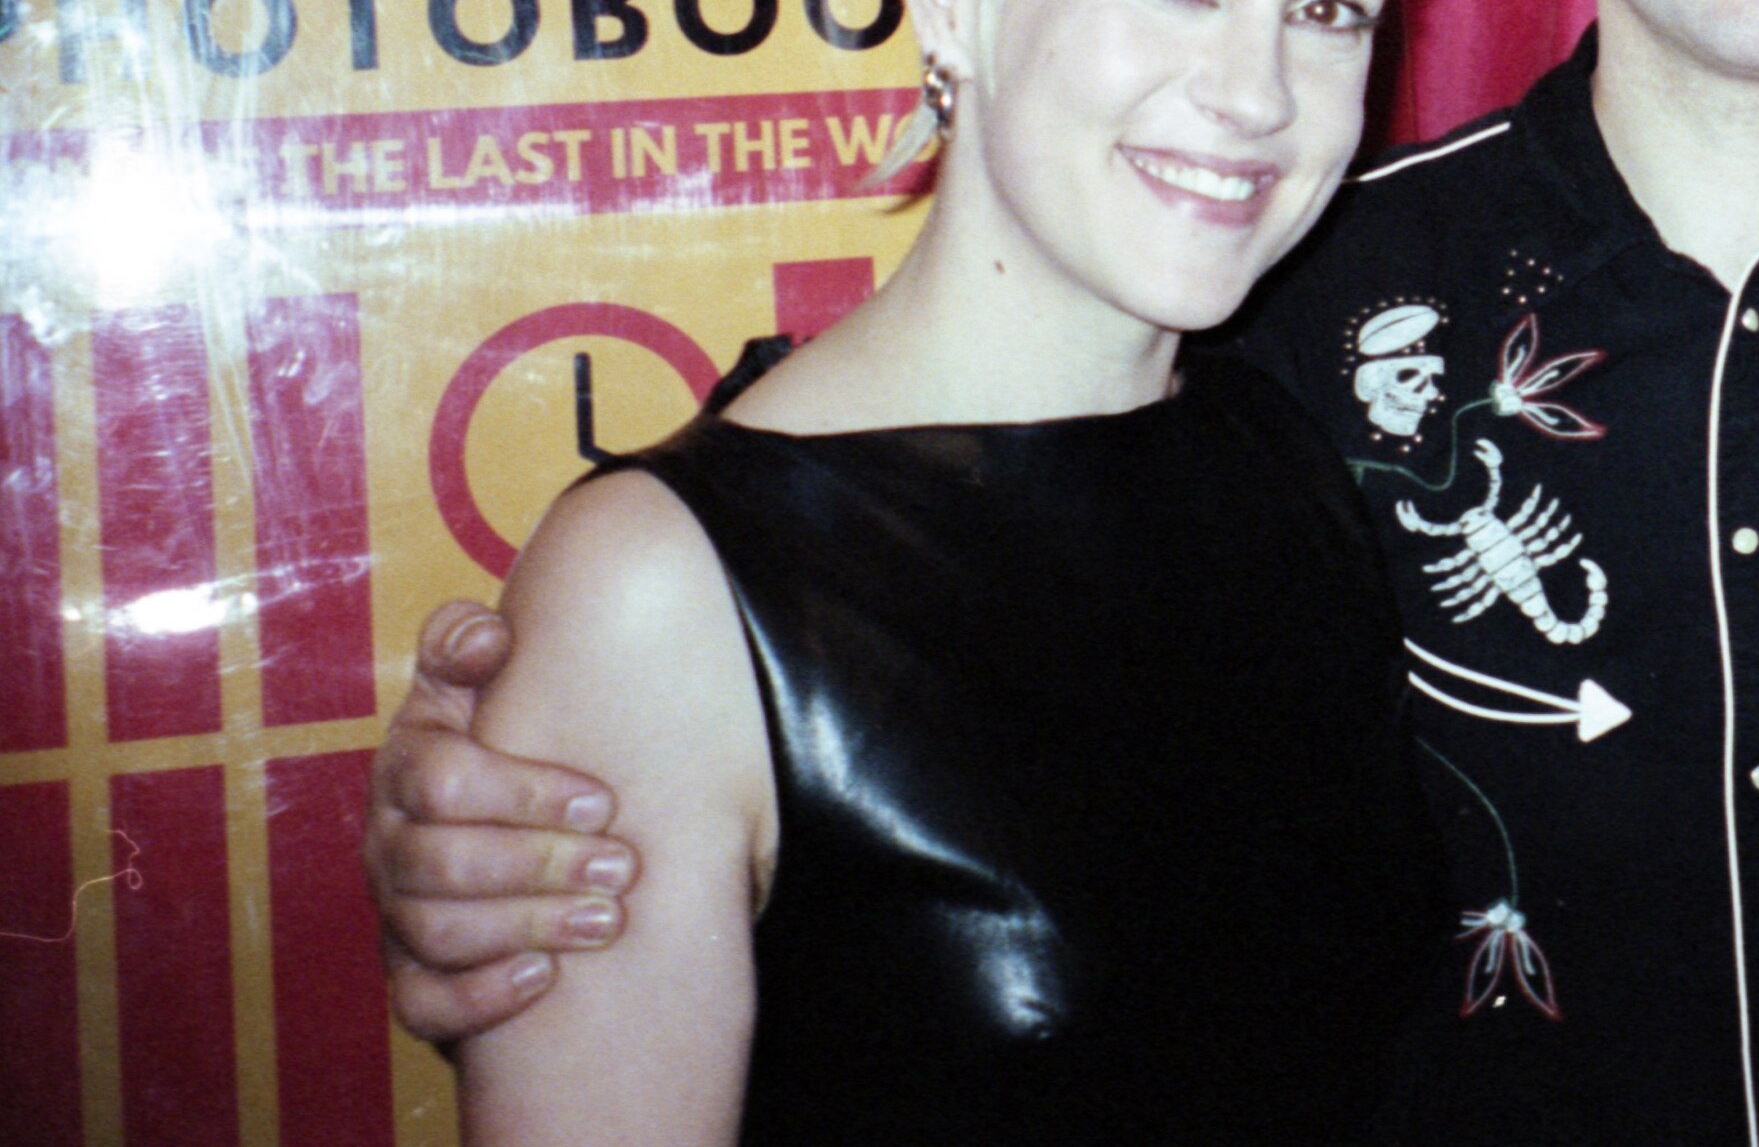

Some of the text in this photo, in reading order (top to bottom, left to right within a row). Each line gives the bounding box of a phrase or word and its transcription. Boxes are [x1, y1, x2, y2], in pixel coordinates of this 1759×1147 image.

[280, 137, 407, 199] THE
[427, 128, 591, 189] LAST
[611, 123, 678, 179] IN
[694, 118, 810, 173] THE
